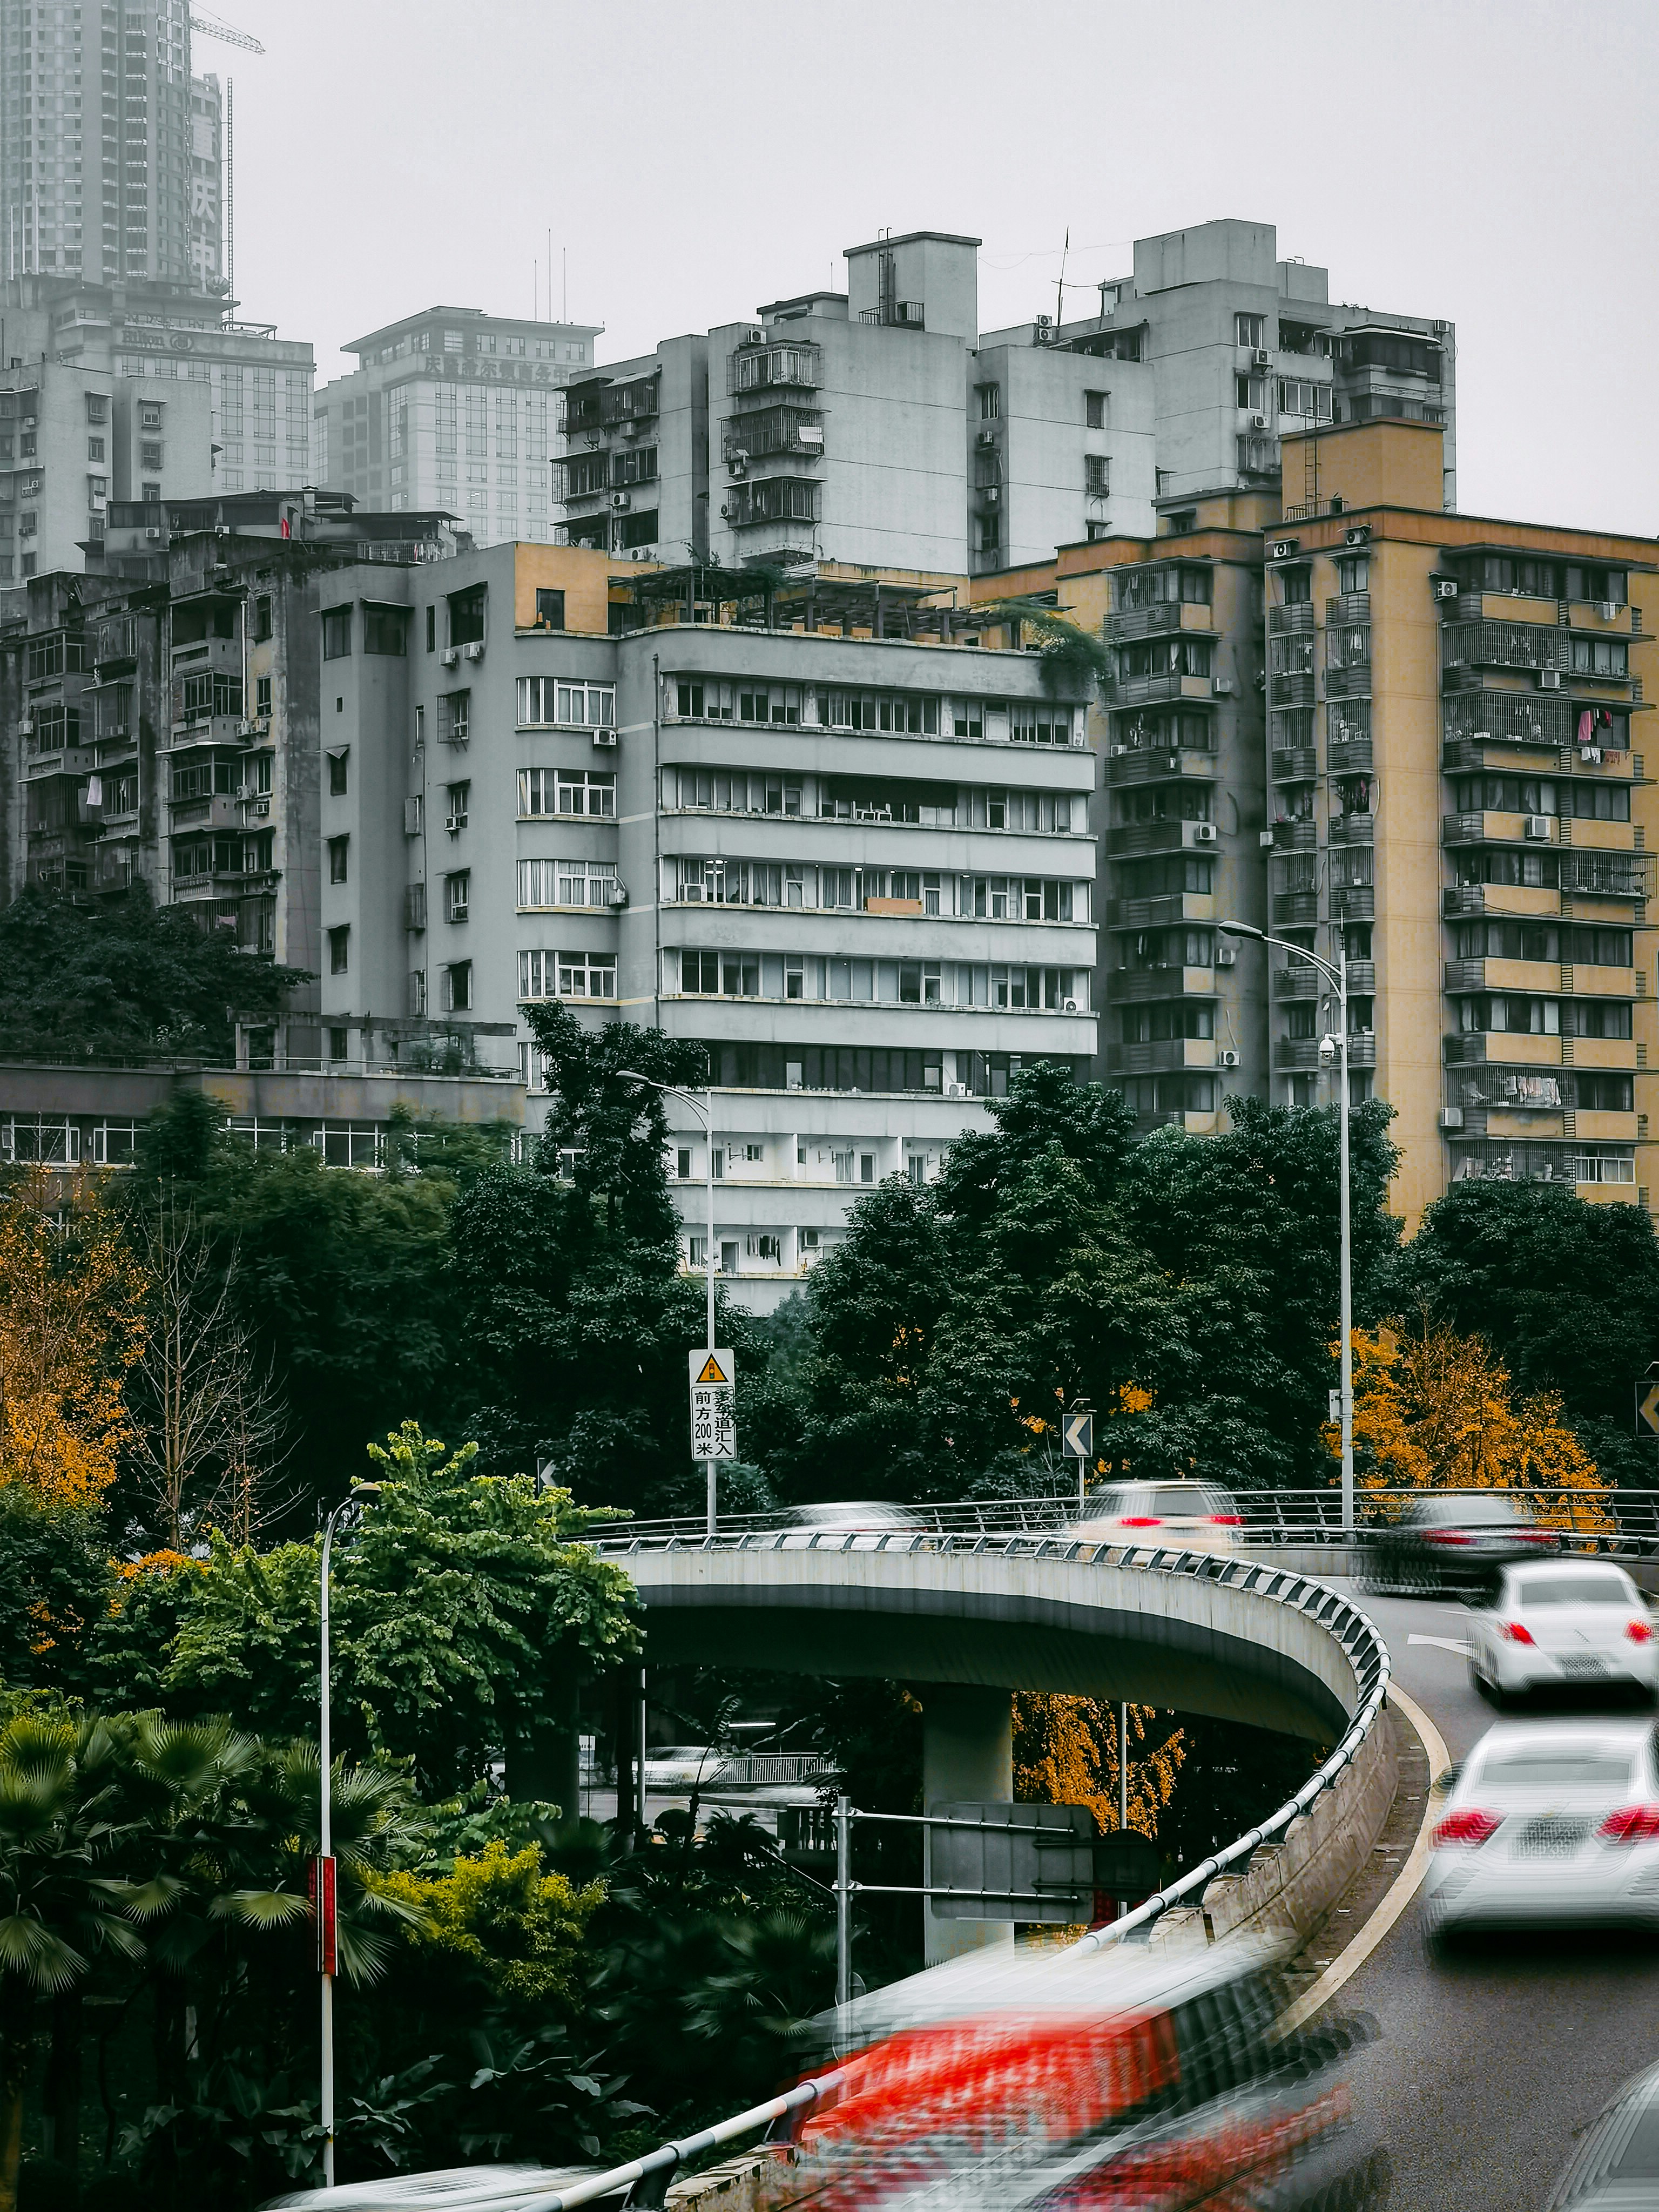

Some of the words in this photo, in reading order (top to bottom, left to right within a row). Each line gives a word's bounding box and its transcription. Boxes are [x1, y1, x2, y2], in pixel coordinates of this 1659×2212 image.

[122, 330, 165, 346] Hilton
[694, 1391, 713, 1456] 前方200米
